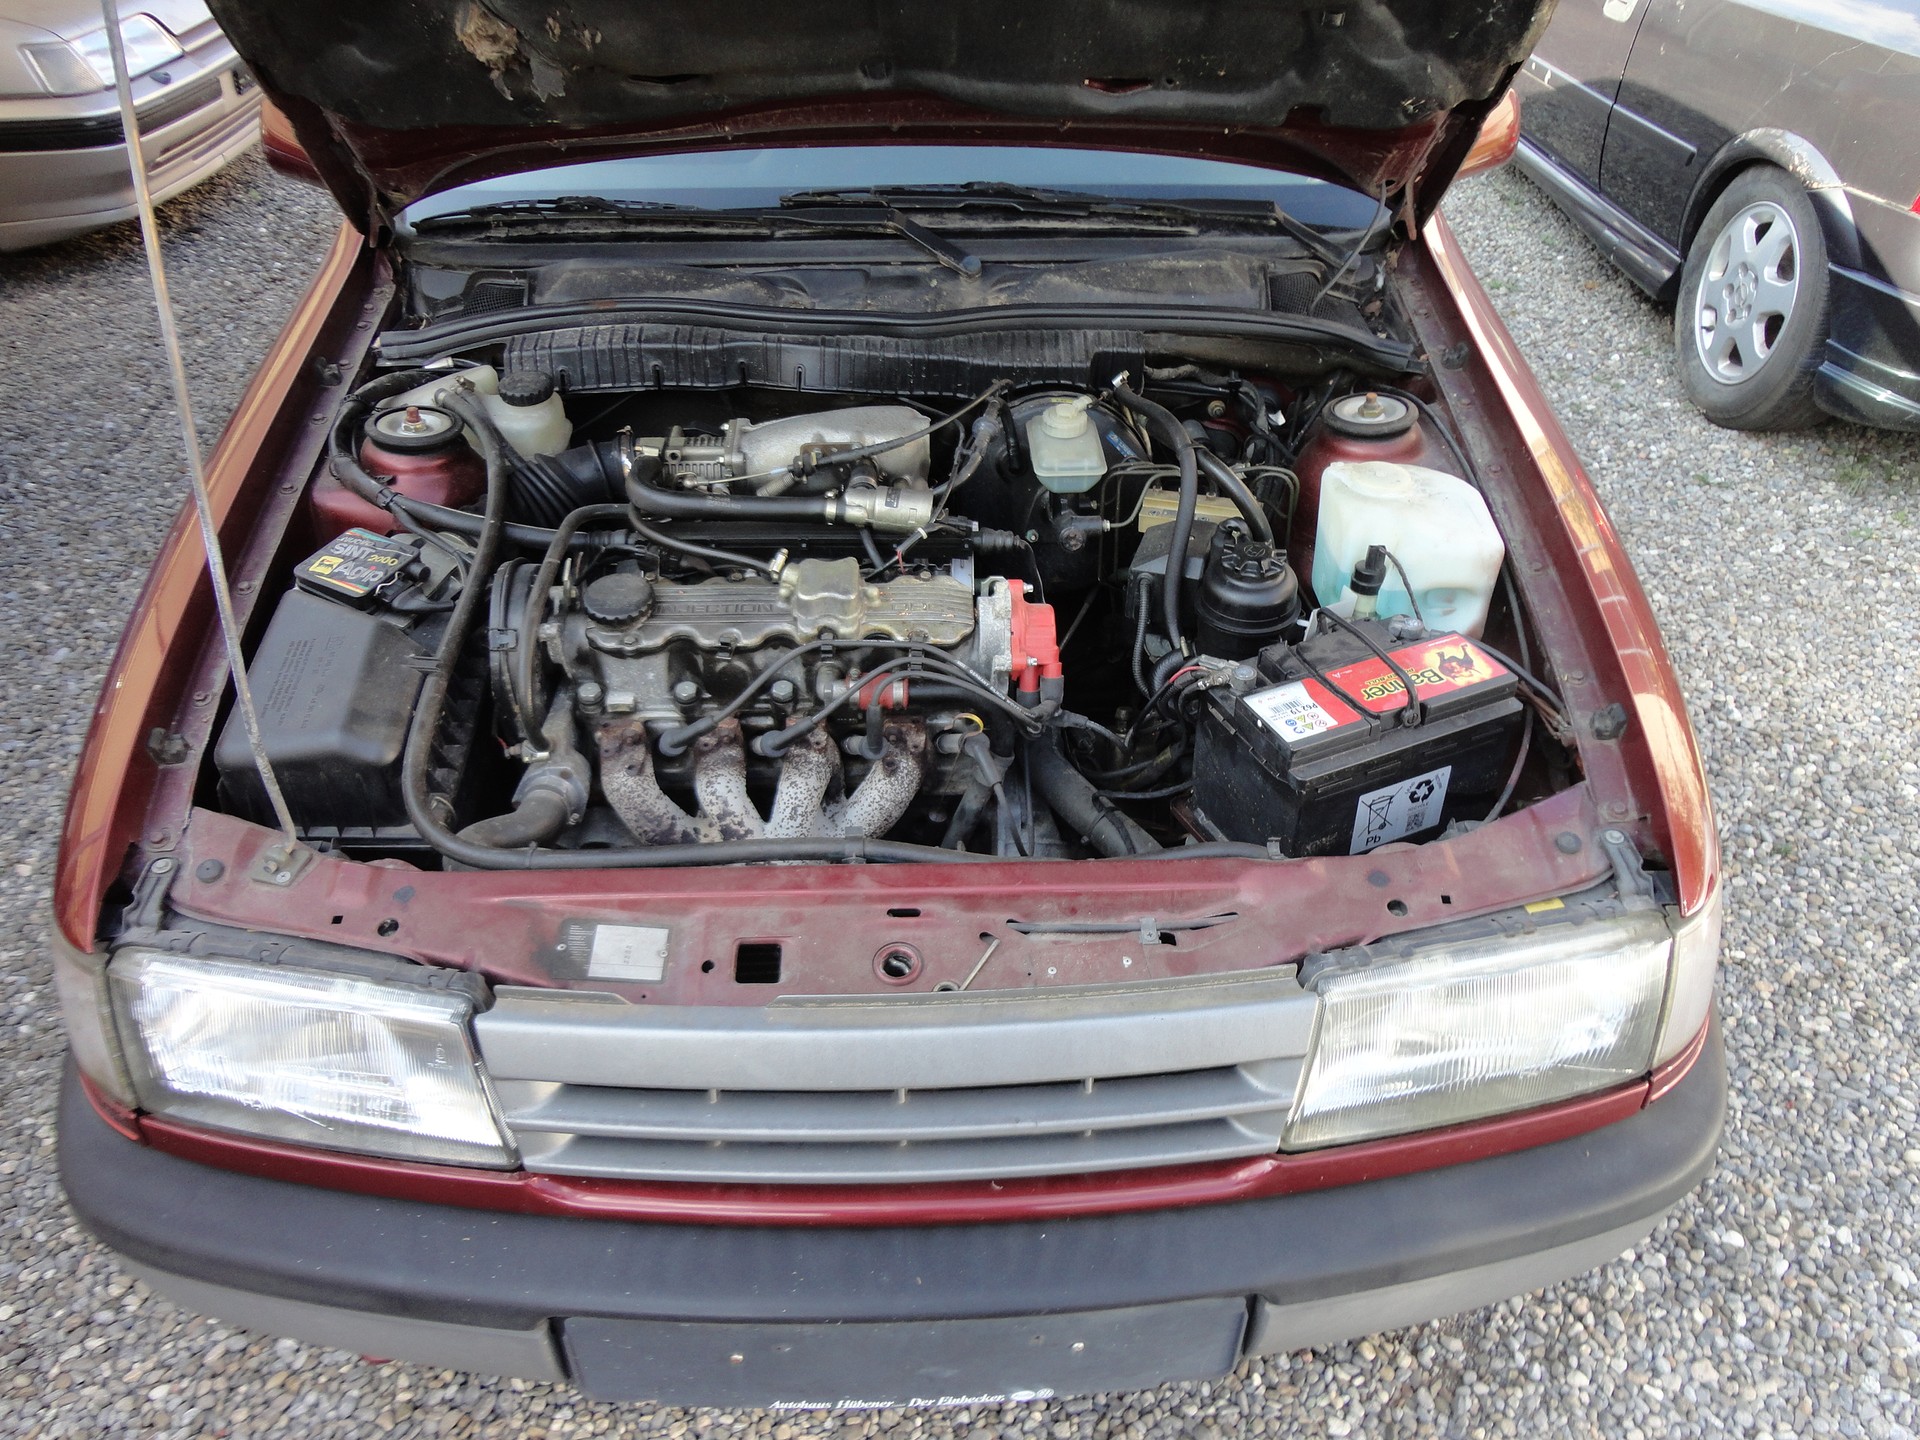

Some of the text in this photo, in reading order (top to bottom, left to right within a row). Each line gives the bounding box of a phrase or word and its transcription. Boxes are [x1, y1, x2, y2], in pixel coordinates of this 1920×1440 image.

[331, 543, 399, 566] SINT 2000
[333, 560, 384, 582] Agip
[1366, 834, 1381, 846] Pb
[768, 1400, 832, 1409] Autohaus
[908, 1397, 936, 1407] Der
